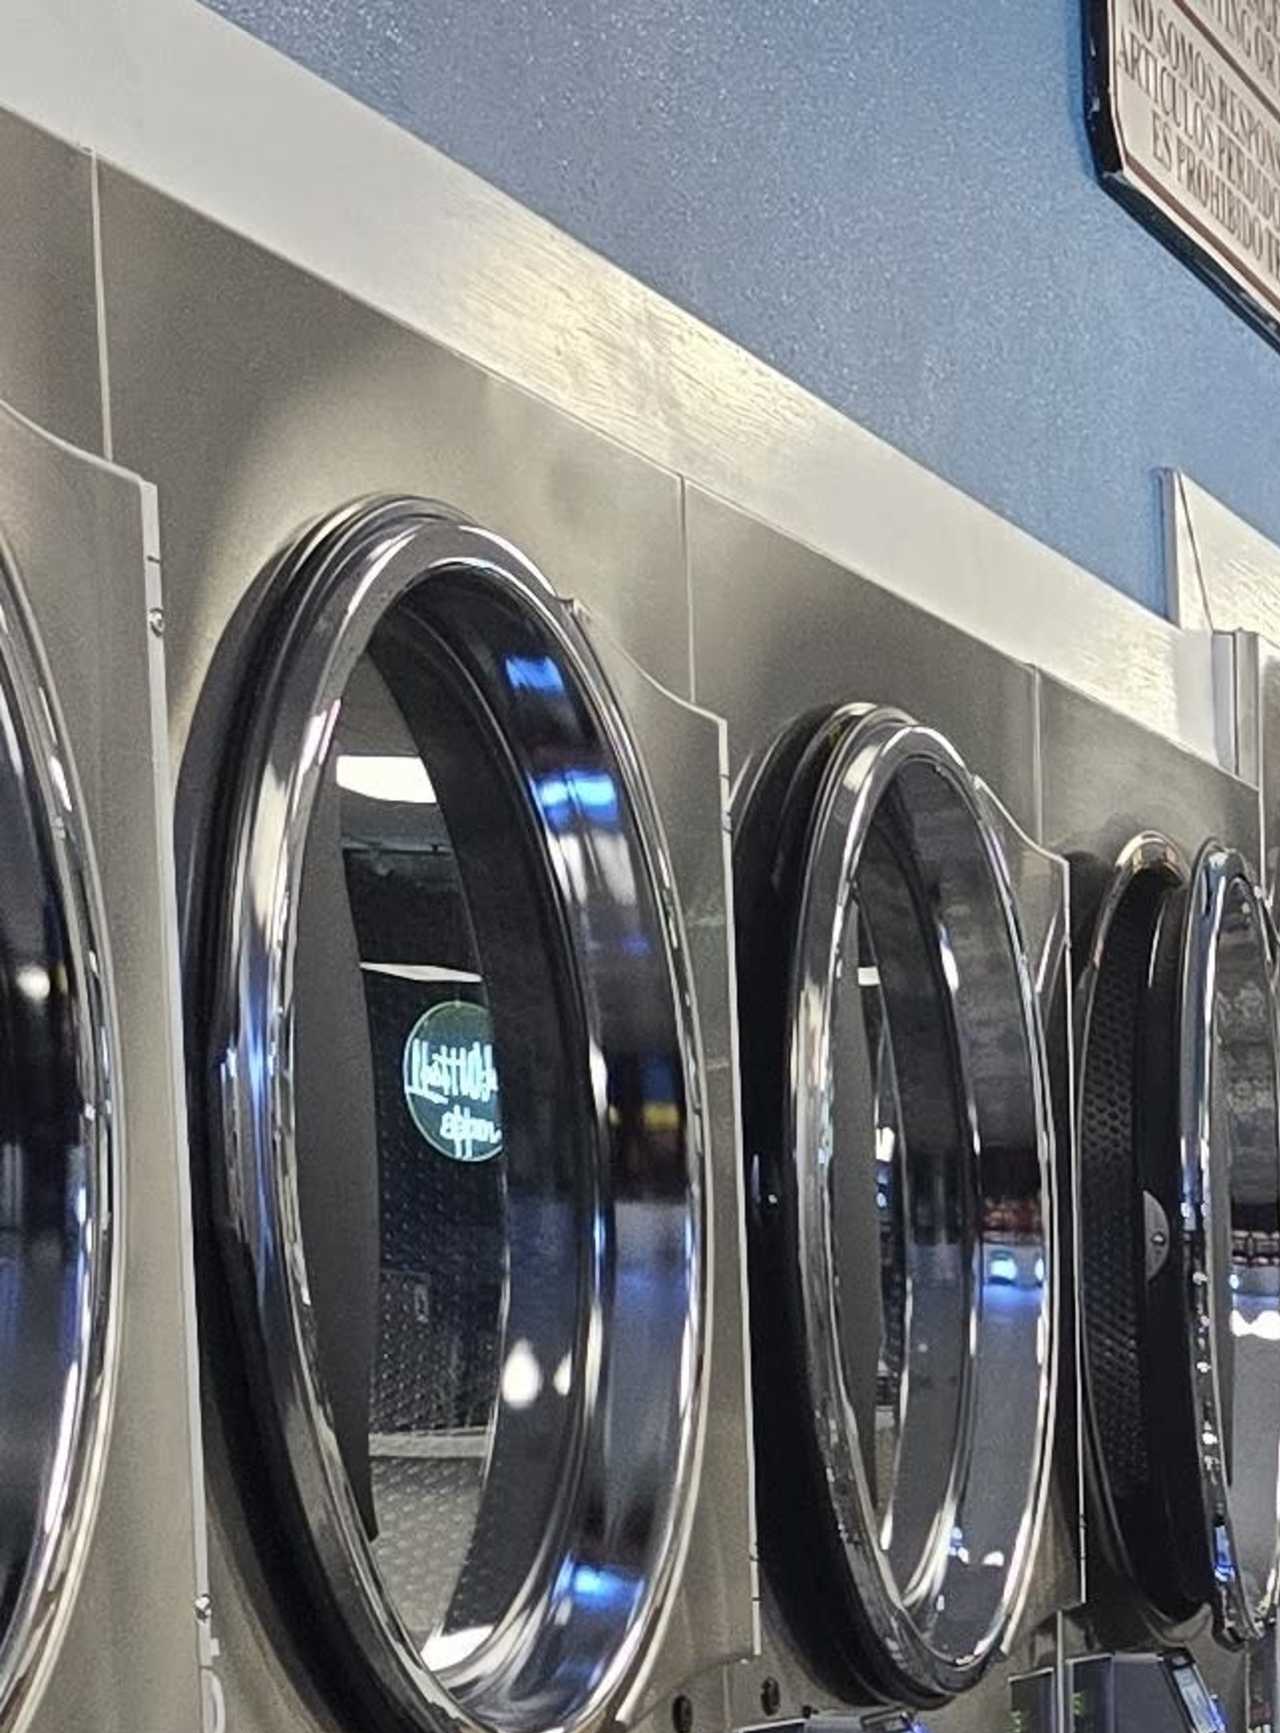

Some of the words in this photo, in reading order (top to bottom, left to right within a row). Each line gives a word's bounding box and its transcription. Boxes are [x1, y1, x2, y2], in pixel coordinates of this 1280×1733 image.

[1119, 19, 1214, 163] ARTICULOS
[1156, 4, 1215, 114] SOMOS
[1153, 109, 1171, 173] ES
[1176, 132, 1262, 264] PROHIBIDO
